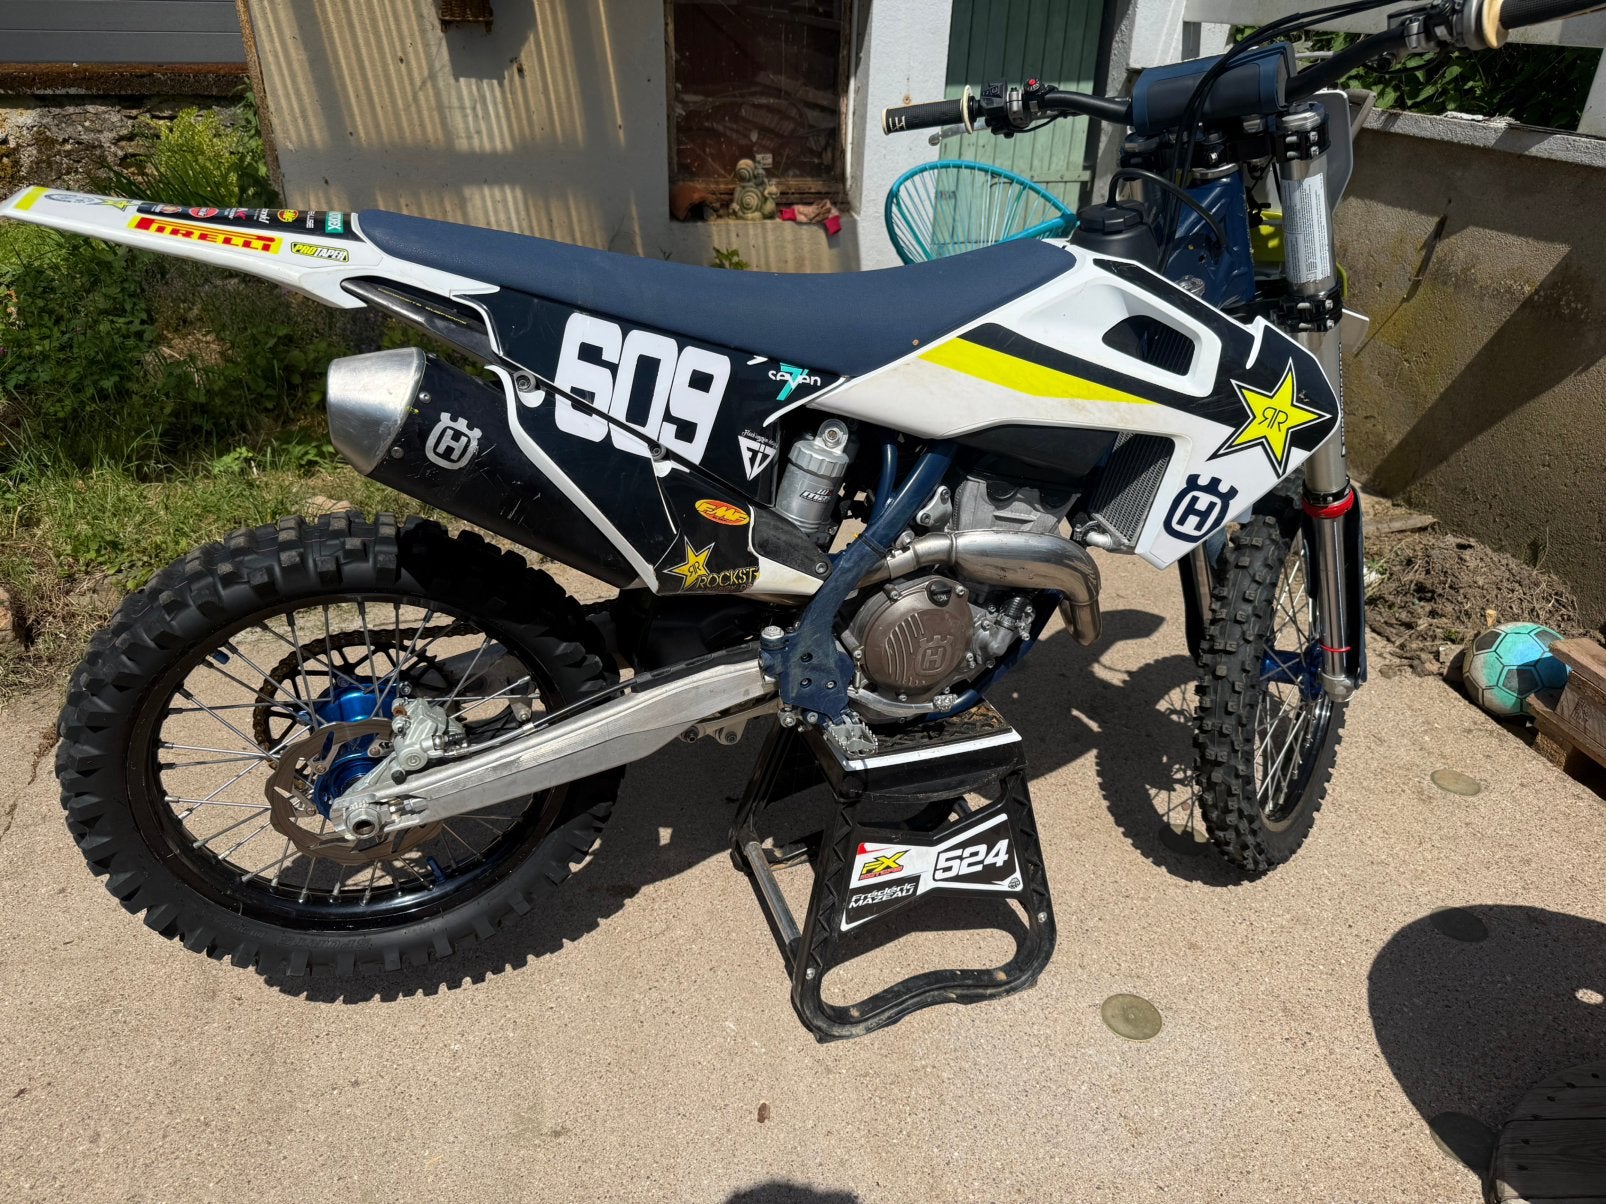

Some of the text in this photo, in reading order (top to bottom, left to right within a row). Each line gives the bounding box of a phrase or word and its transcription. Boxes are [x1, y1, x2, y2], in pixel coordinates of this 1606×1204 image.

[135, 217, 276, 252] PIRELLI
[554, 312, 731, 466] 609
[697, 501, 750, 522] FMF
[861, 849, 912, 876] FX
[934, 838, 1009, 881] 524
[848, 888, 914, 909] MAZEAU
